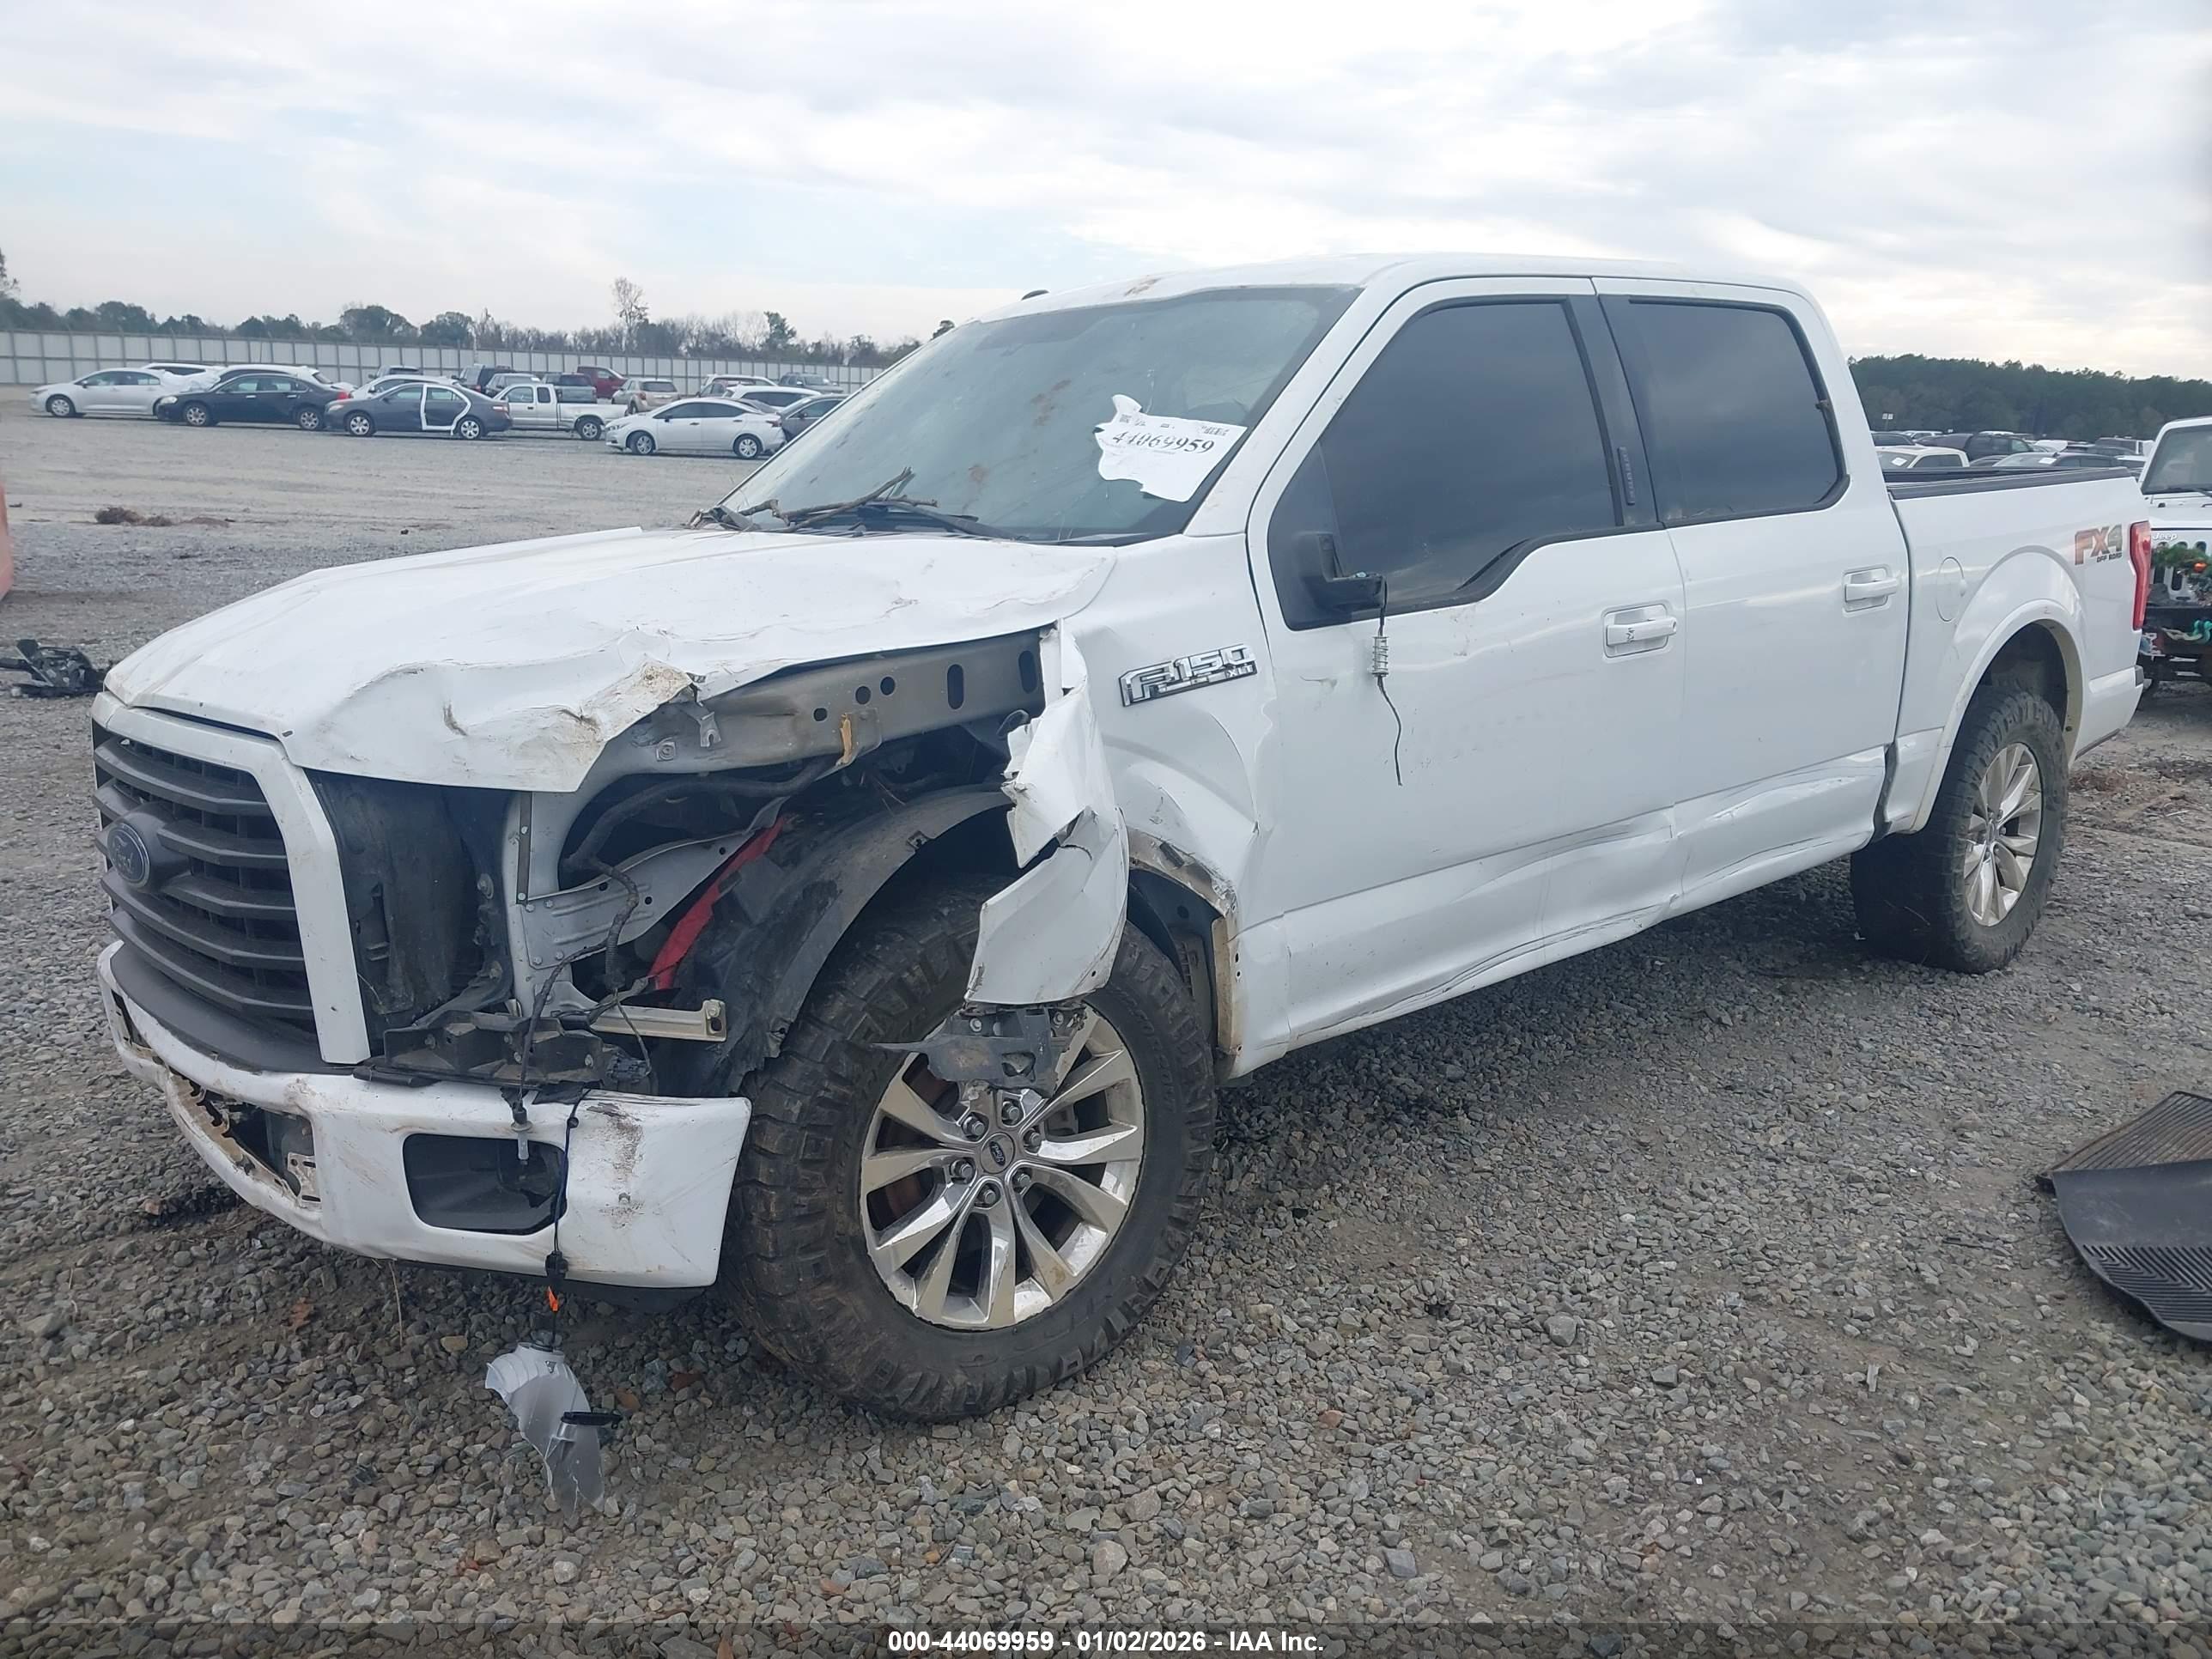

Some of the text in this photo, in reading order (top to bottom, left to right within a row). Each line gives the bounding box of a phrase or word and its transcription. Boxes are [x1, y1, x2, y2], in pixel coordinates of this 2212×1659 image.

[1113, 431, 1215, 453] 44069959
[2075, 524, 2123, 565] FX4
[2153, 532, 2178, 542] Jeep
[1227, 664, 1254, 678] XLT
[991, 1143, 1006, 1164] Ford
